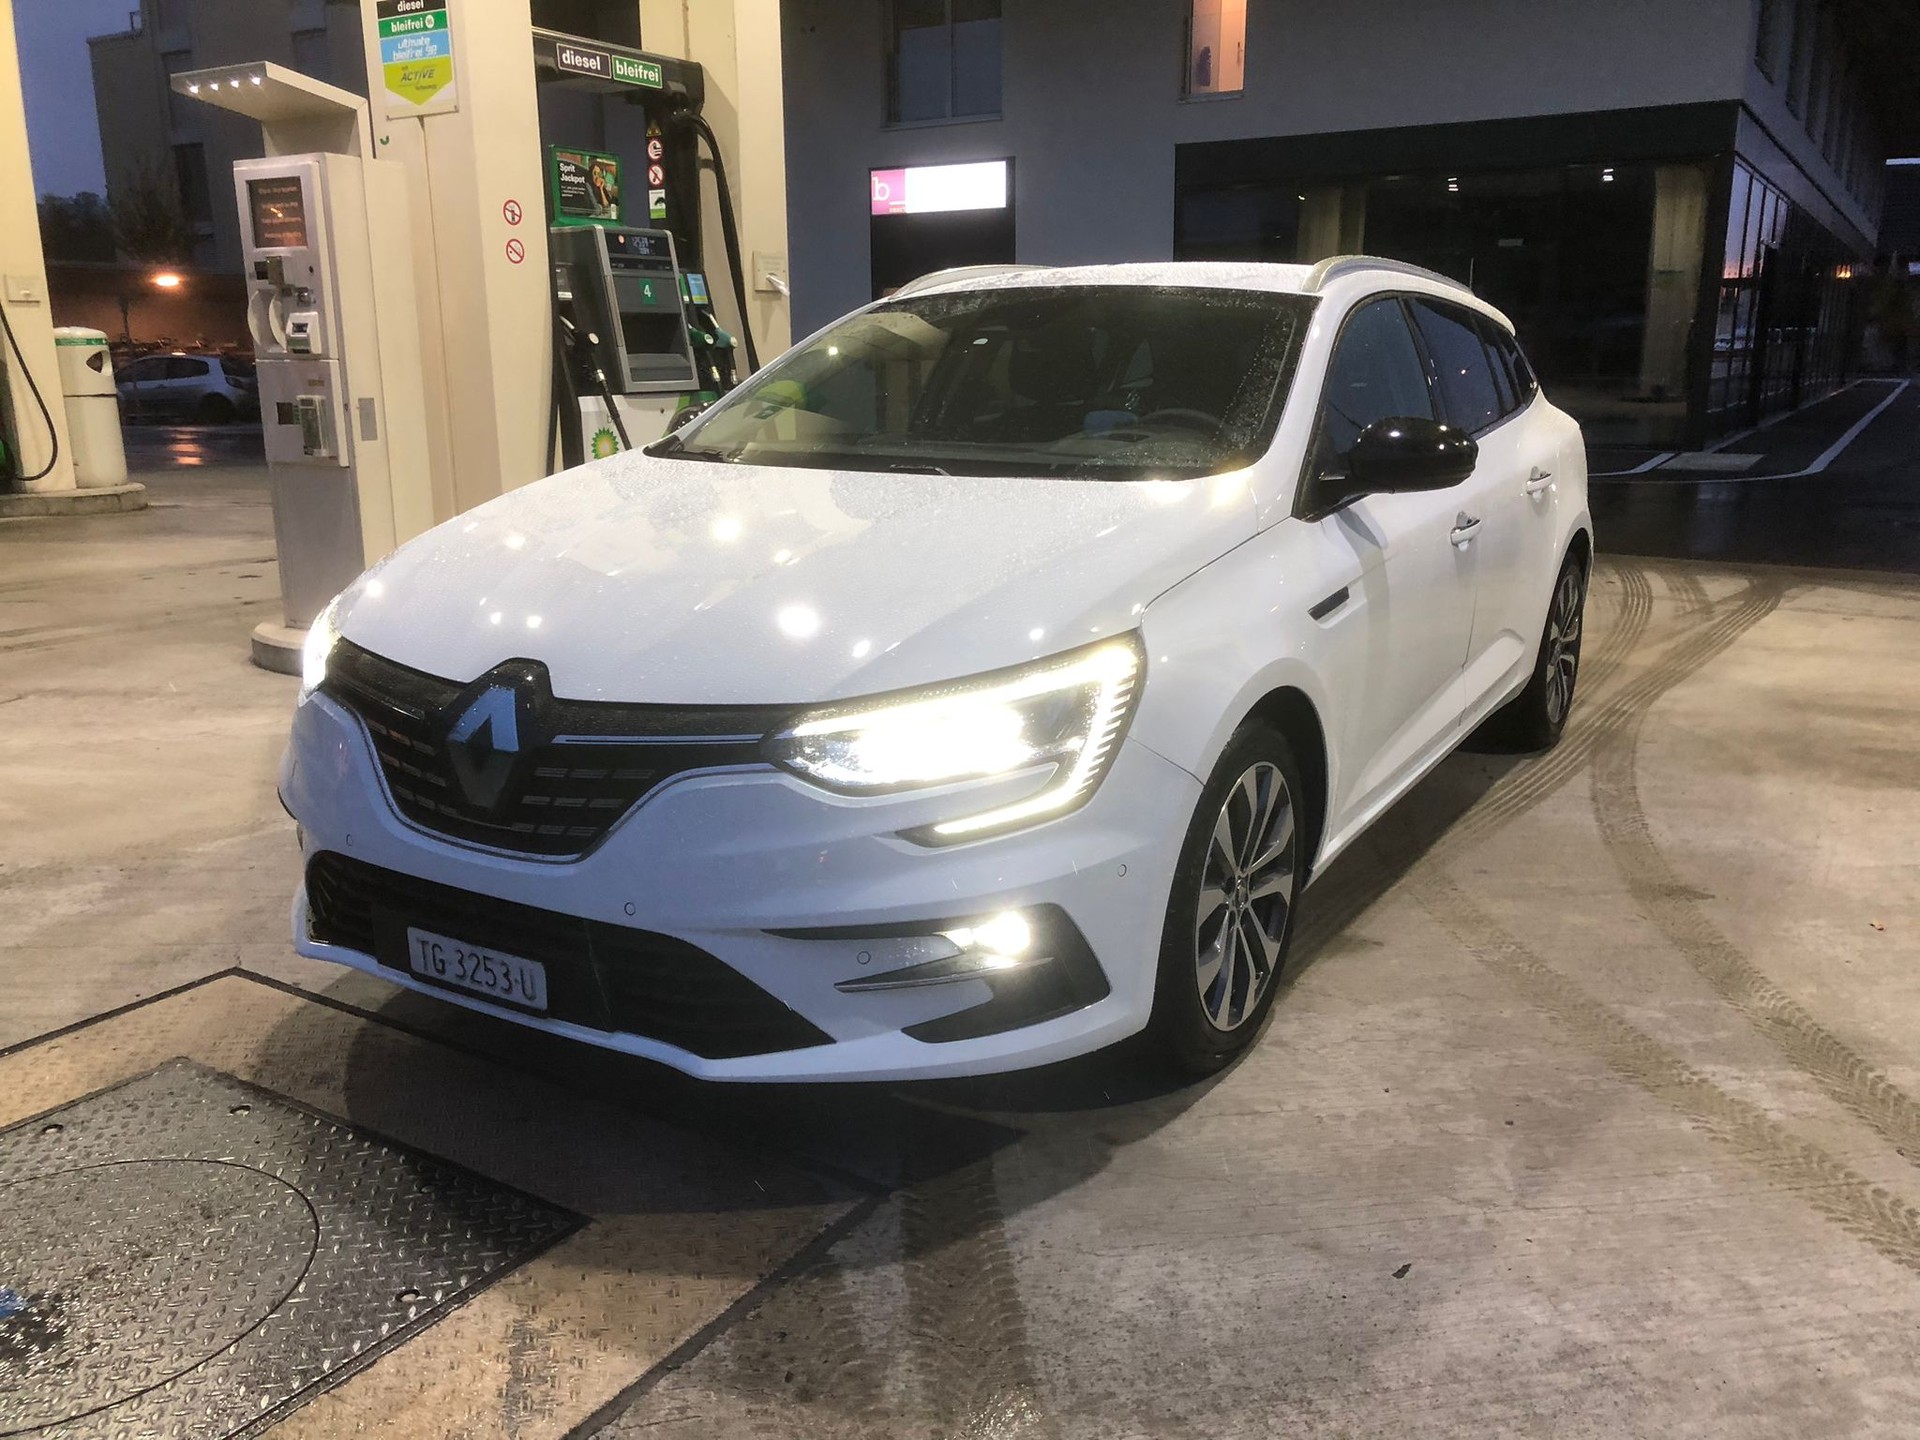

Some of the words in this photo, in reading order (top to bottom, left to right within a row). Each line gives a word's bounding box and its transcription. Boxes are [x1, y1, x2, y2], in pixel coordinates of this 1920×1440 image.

[397, 0, 424, 12] diesel
[391, 18, 424, 32] bleifrei
[561, 50, 601, 71] diesel
[401, 69, 435, 81] ACTIVE
[615, 60, 659, 82] bleifrei
[559, 162, 576, 173] Sprit
[560, 173, 586, 184] Jackpot
[643, 284, 652, 298] 4
